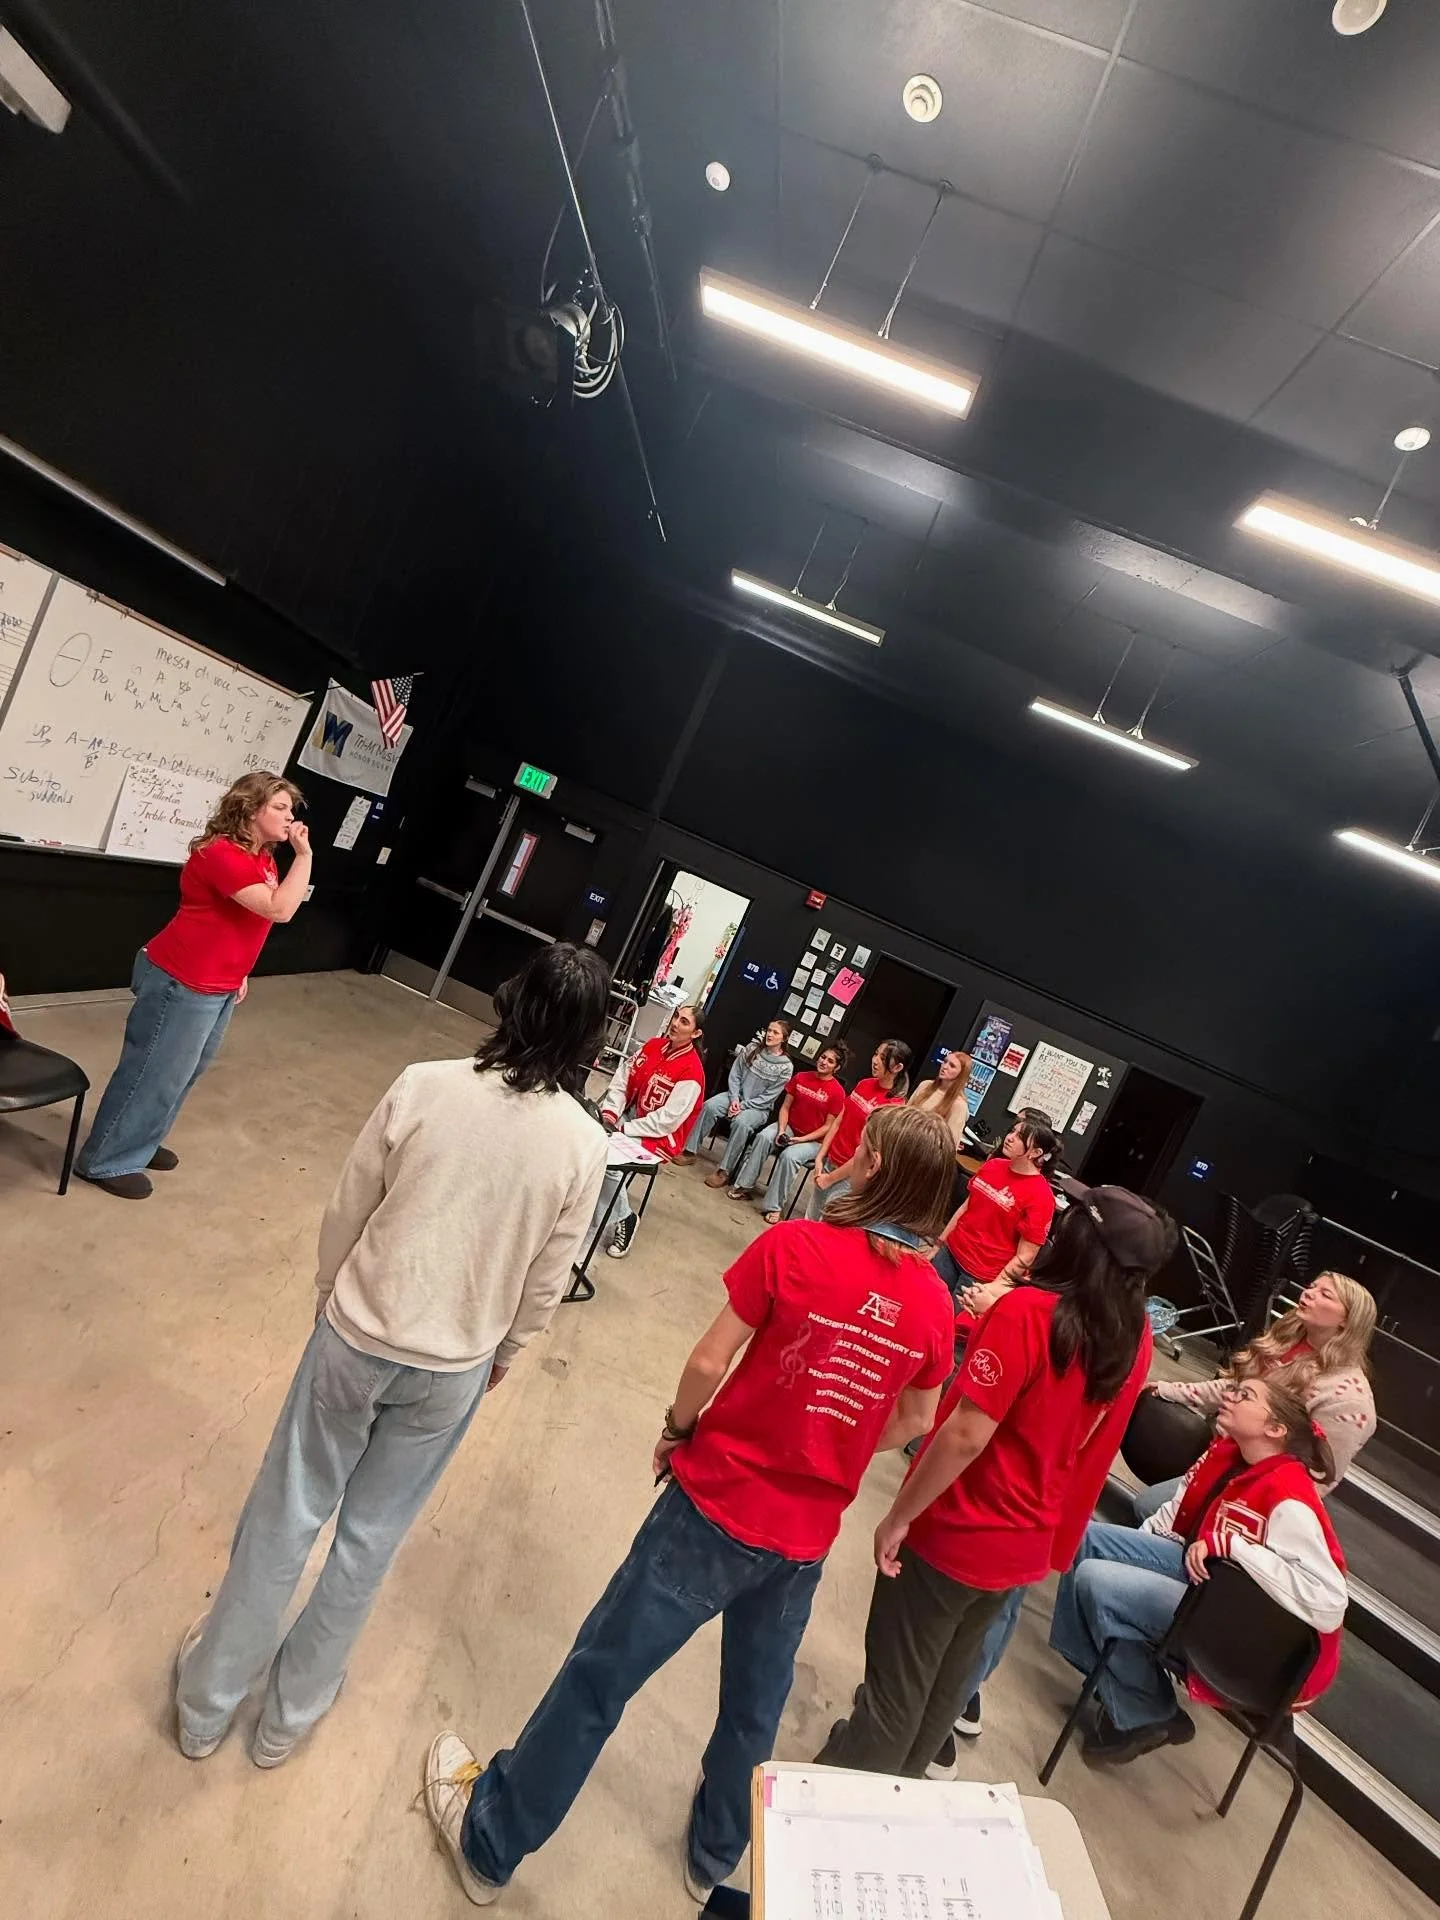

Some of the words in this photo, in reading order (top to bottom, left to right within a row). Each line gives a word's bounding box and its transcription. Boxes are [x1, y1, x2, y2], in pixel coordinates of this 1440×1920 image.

[3, 766, 62, 791] Subito
[519, 766, 551, 794] EXIT
[140, 801, 167, 821] Treble
[589, 892, 605, 904] EXIT
[1065, 1057, 1078, 1067] YOU
[808, 1312, 844, 1330] MARCHING
[867, 1332, 910, 1355] PAGEANTRY
[852, 1344, 891, 1367] ENSEMBLE
[808, 1367, 850, 1386] PERCUSSION
[829, 1357, 861, 1371] CONCERT
[861, 1364, 882, 1382] BAND
[816, 1406, 858, 1427] ORCHESTRA
